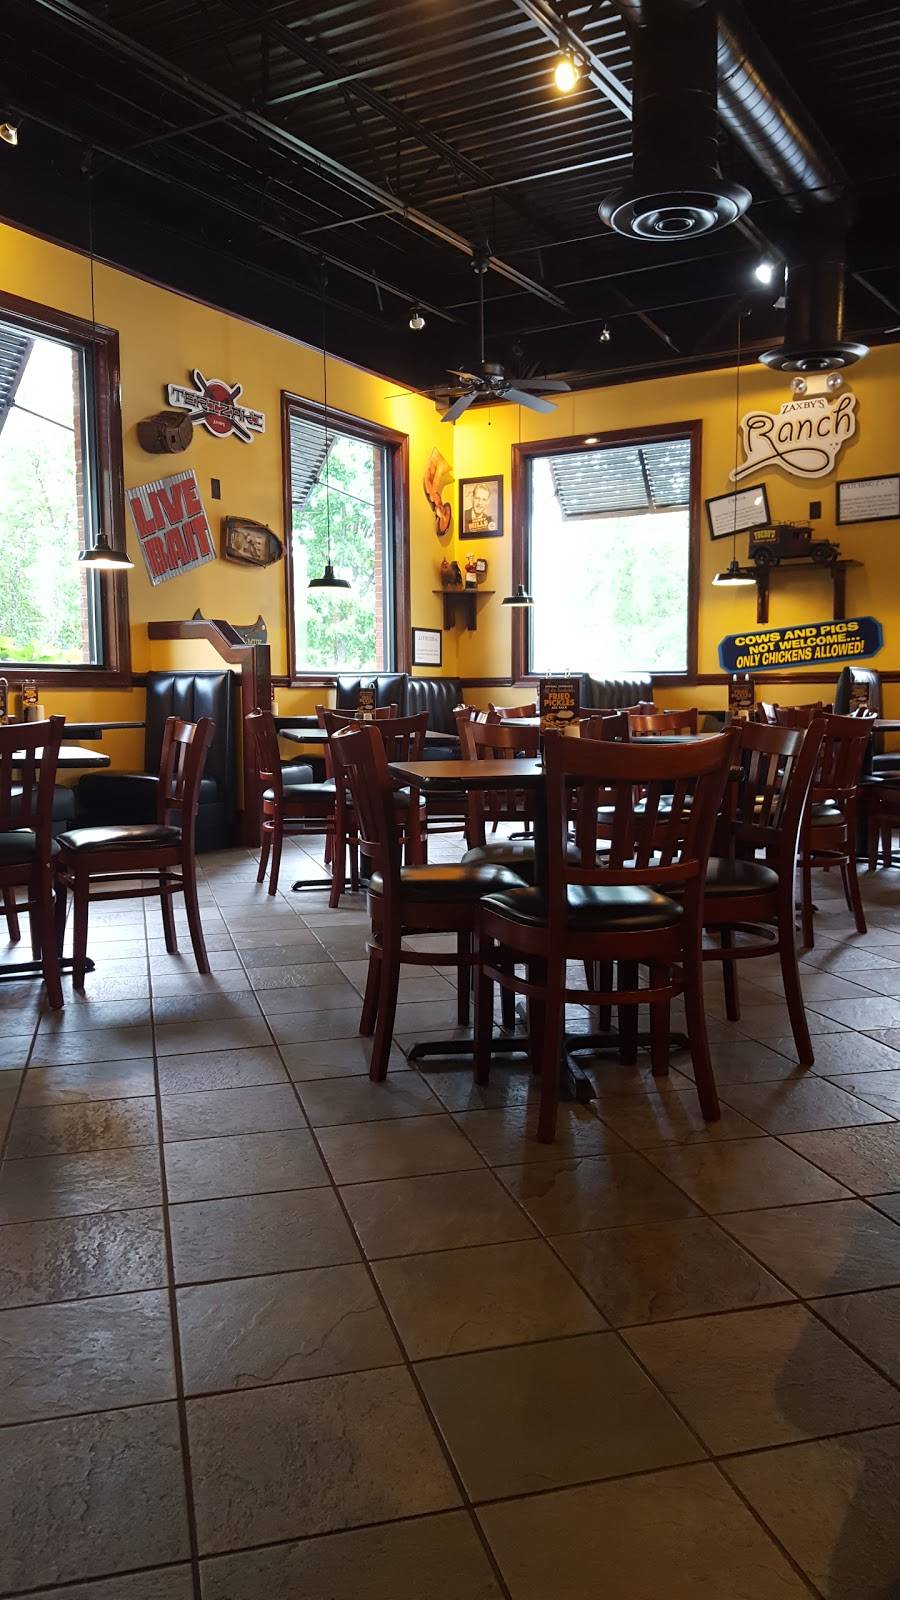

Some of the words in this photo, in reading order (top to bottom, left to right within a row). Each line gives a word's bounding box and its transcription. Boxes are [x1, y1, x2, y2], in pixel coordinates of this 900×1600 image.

[782, 400, 825, 415] ZAXBY'S
[735, 397, 851, 473] Ranch
[130, 478, 202, 538] LIVE
[144, 515, 211, 578] BAIT
[734, 632, 781, 646] COWS
[784, 627, 817, 640] AND
[820, 621, 859, 635] PIGS
[749, 641, 775, 655] NOT
[778, 633, 861, 648] WELCOME...
[736, 654, 761, 669] ONLY
[761, 648, 812, 665] CHICKENS
[814, 640, 865, 659] ALLOWED!
[543, 699, 575, 707] PICKLES
[548, 692, 570, 700] FRIED
